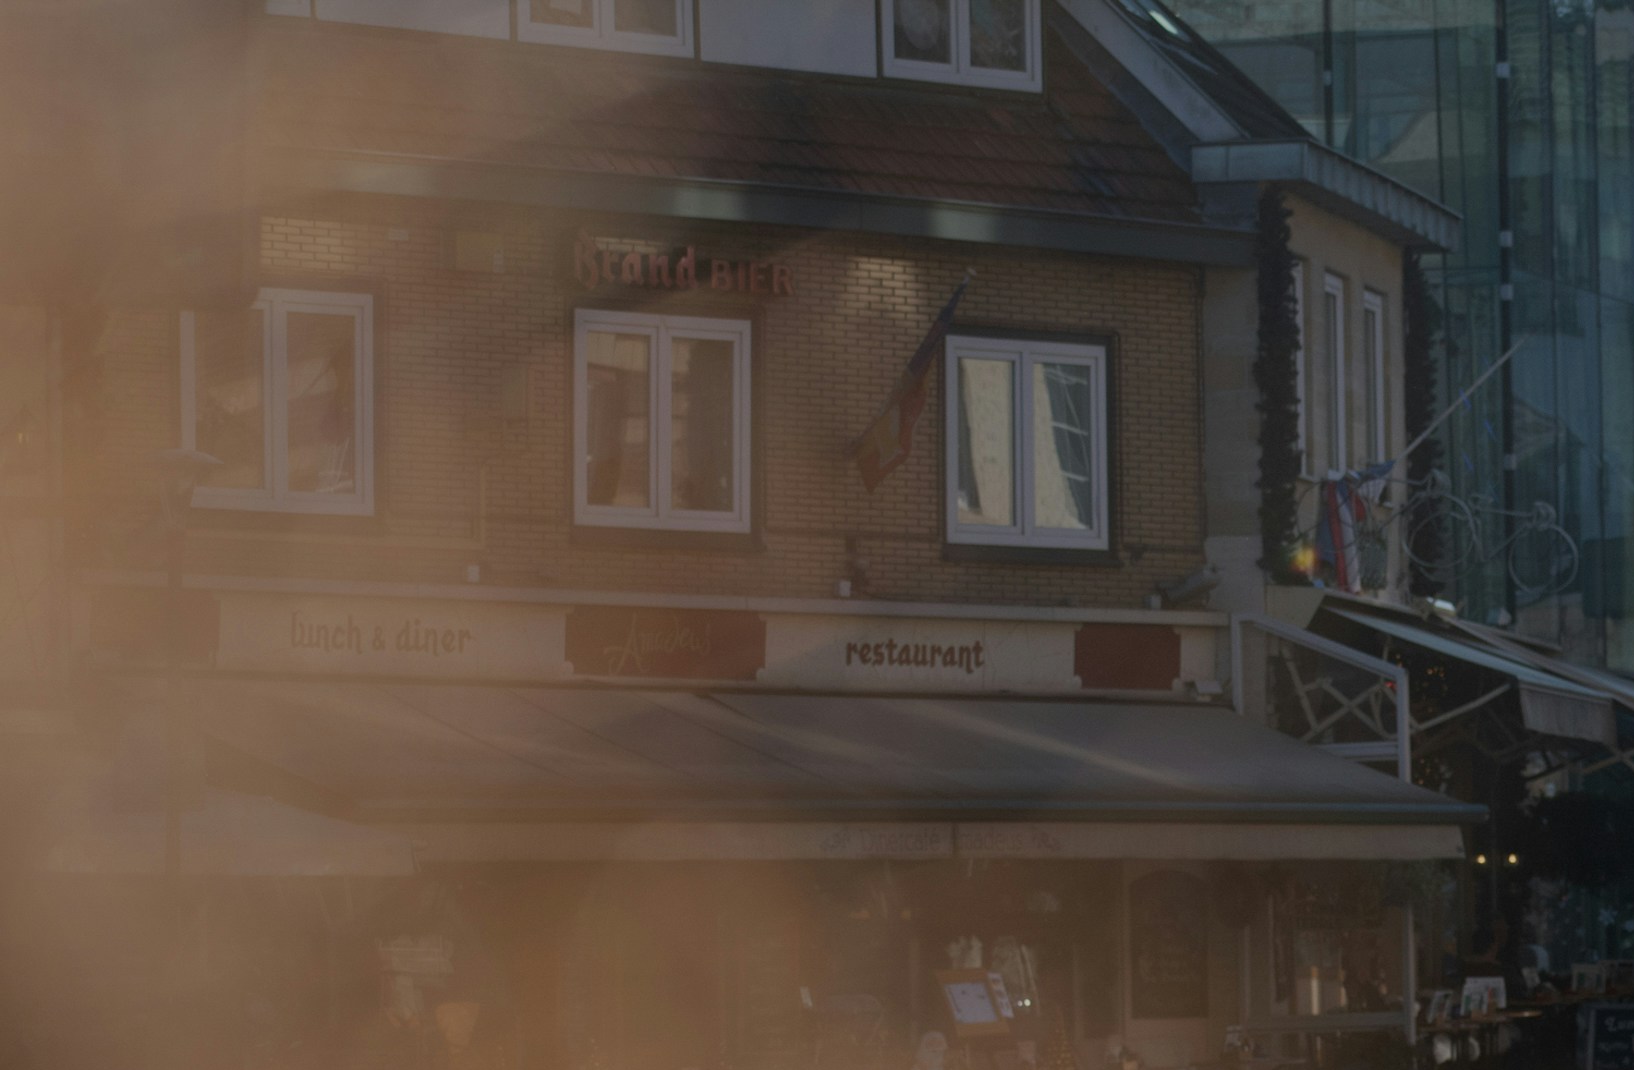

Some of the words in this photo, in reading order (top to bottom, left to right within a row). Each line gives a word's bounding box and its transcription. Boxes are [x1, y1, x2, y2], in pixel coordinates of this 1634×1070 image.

[574, 228, 699, 290] Brand
[711, 258, 796, 296] BIER
[372, 625, 386, 651] &
[396, 618, 474, 657] diner
[846, 638, 985, 674] restaurant
